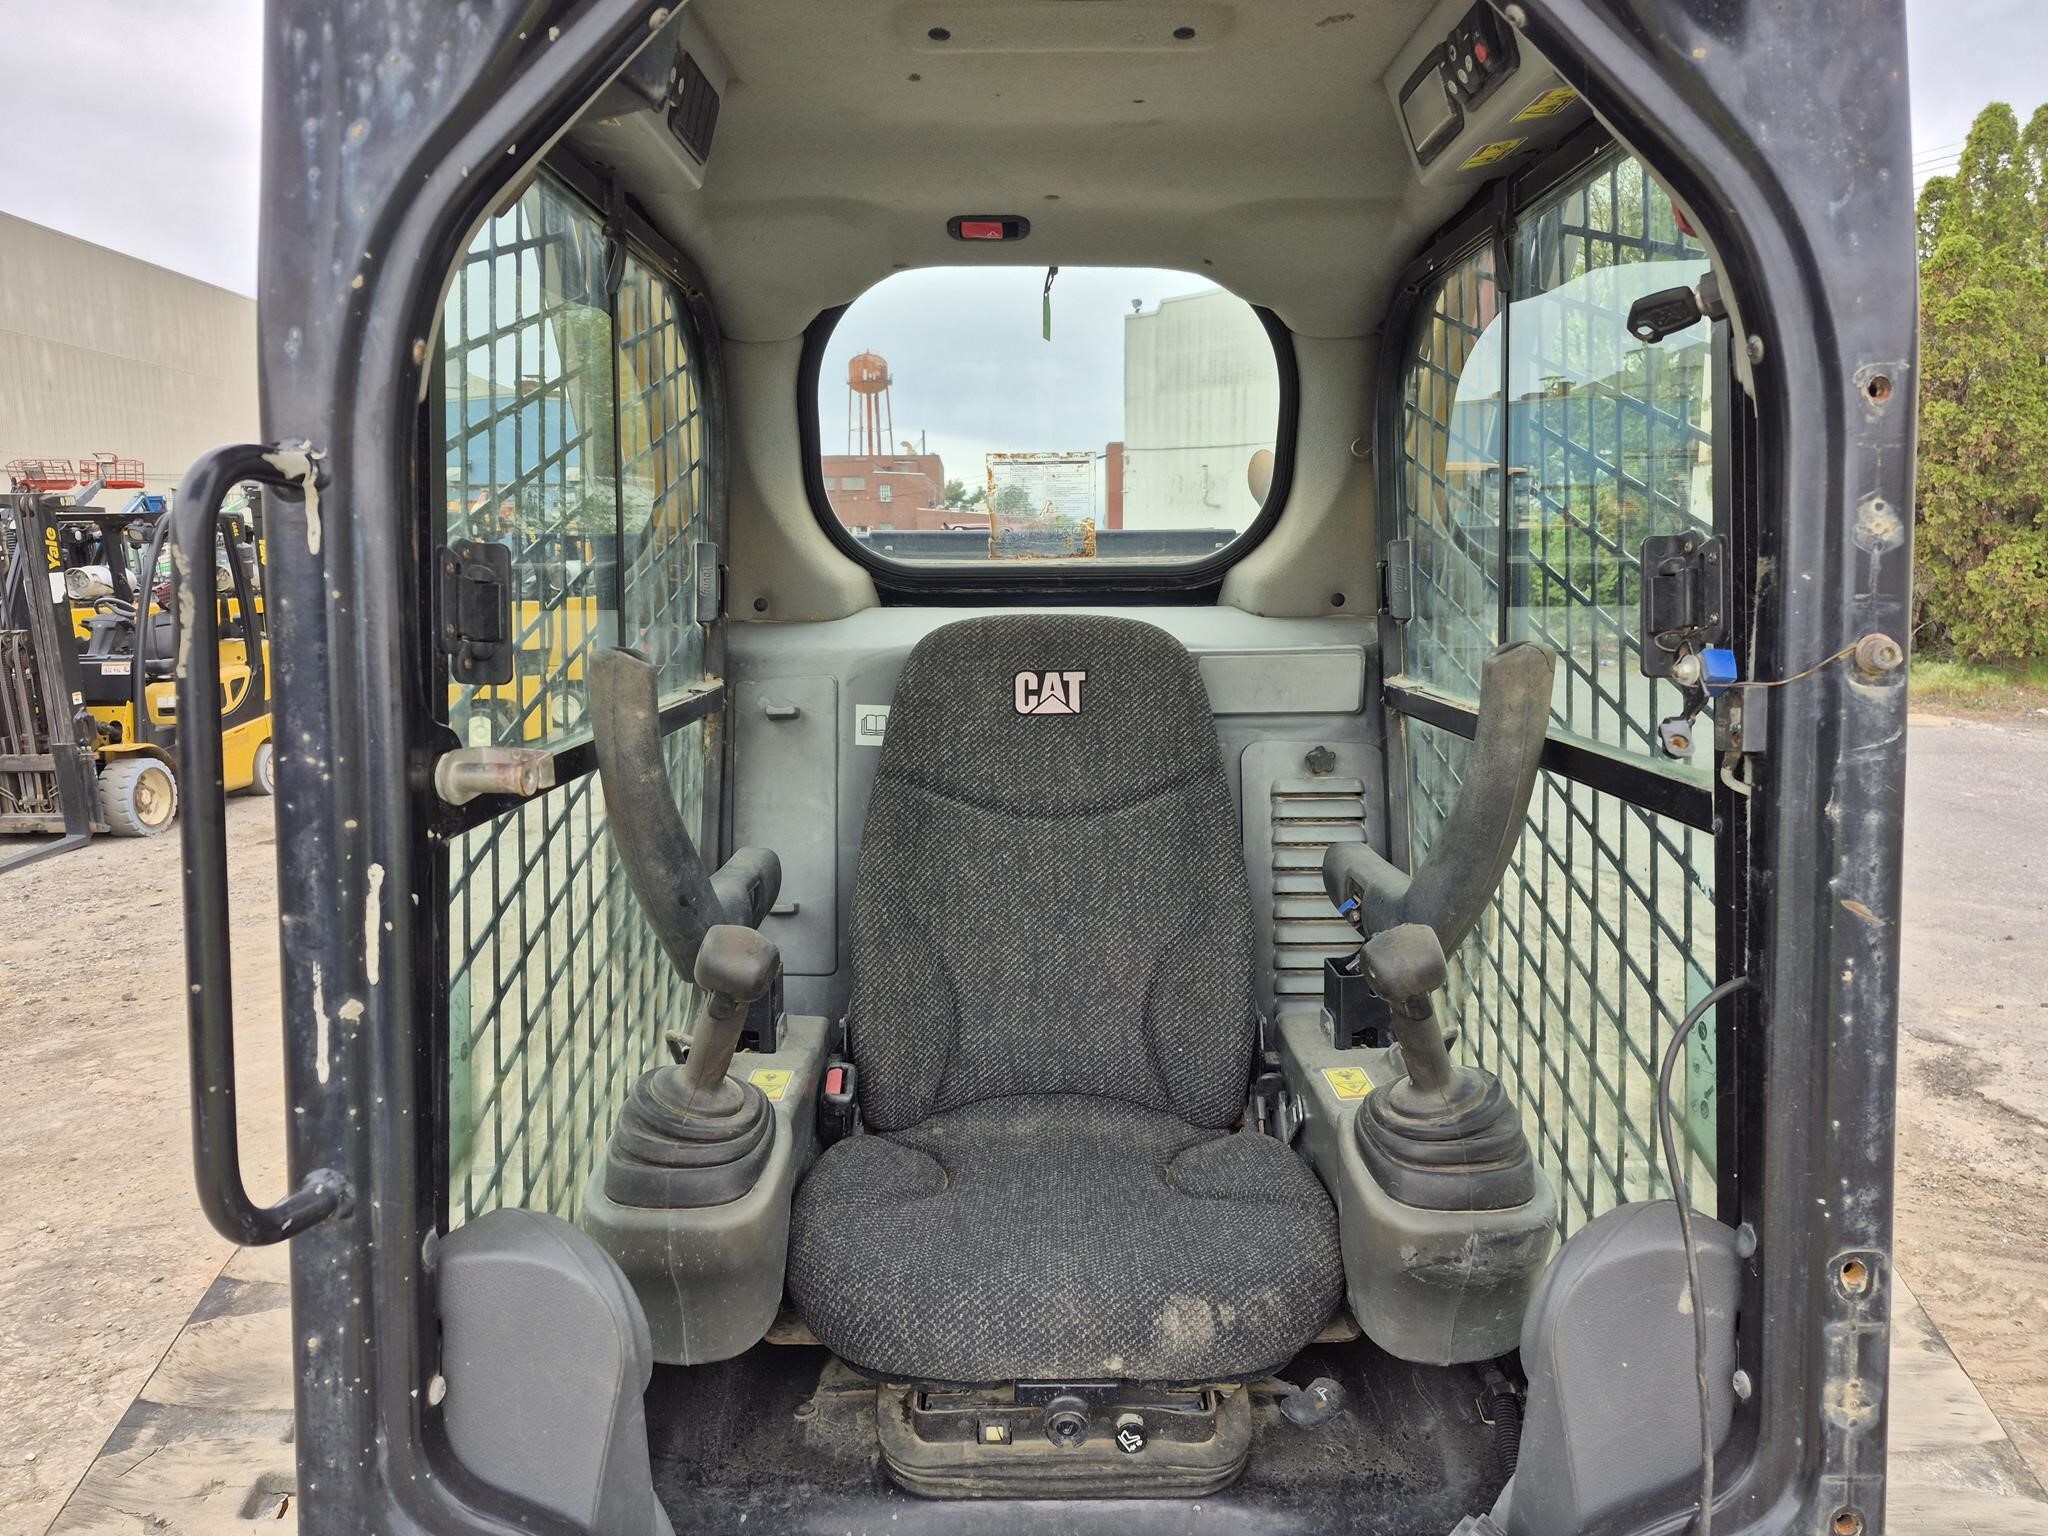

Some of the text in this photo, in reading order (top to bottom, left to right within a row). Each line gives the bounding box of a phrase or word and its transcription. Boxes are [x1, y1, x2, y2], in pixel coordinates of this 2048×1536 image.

[45, 527, 61, 569] Yale
[700, 566, 713, 596] Young
[1015, 671, 1086, 714] CAT
